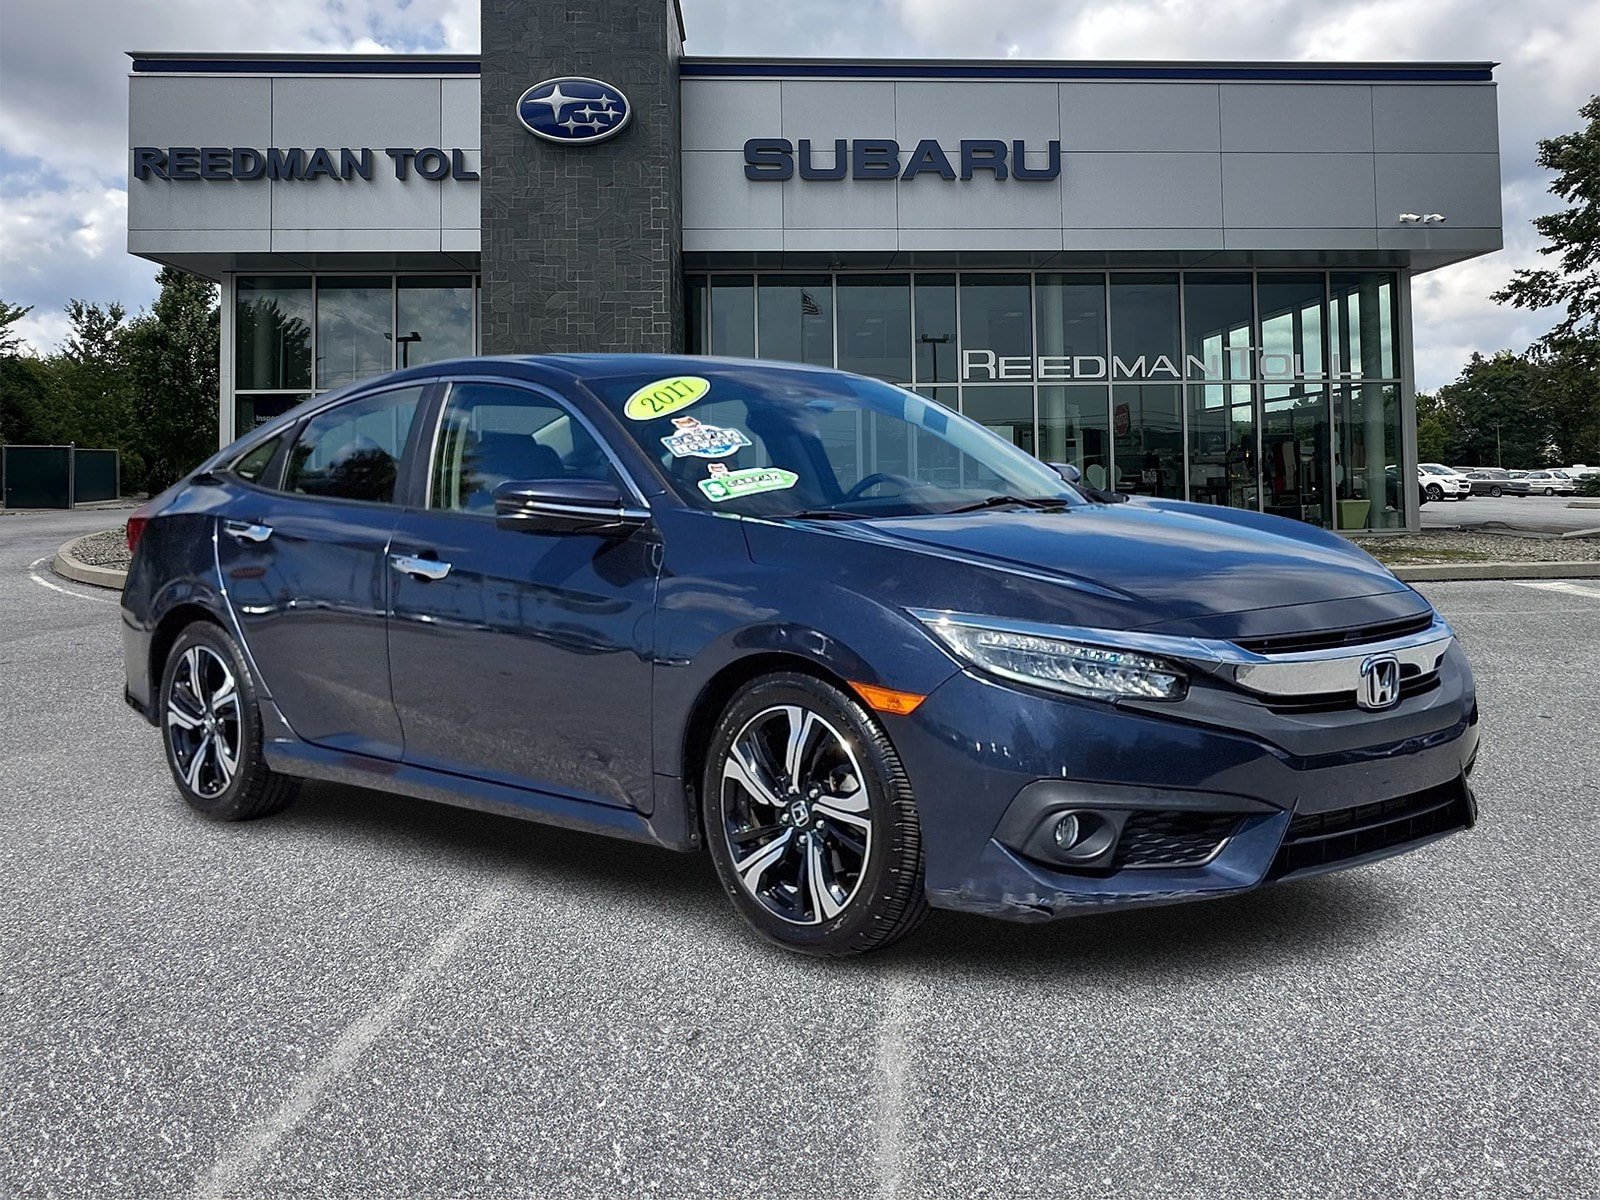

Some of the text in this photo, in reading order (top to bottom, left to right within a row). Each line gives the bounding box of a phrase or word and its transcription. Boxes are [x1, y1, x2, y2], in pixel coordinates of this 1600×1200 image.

[133, 146, 480, 181] REEDMAN TOL
[743, 138, 1062, 181] SUBARU
[641, 380, 695, 413] 2017
